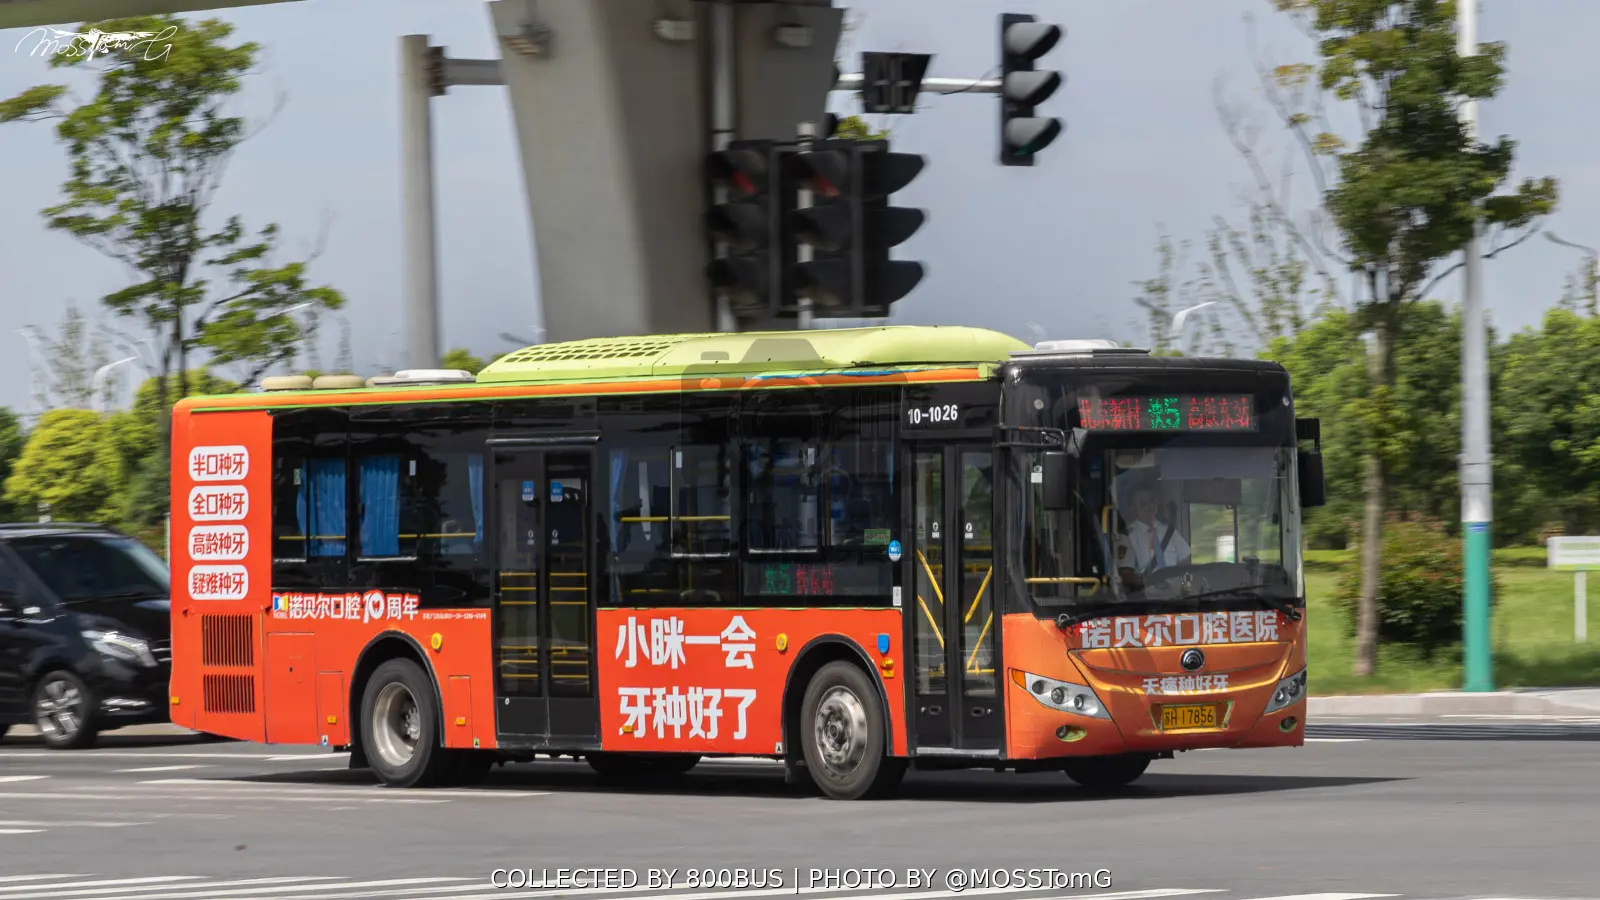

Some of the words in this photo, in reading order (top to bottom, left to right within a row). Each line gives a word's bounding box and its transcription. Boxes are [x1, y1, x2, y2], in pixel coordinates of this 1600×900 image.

[907, 404, 959, 425] 10-1026
[192, 452, 246, 476] 半口种牙
[192, 492, 246, 516] 全口种牙
[192, 532, 246, 556] 高龄种牙
[192, 572, 246, 596] 疑难种牙
[1079, 611, 1280, 649] 诺贝尔口腔医院
[615, 615, 757, 670] 小眯一会
[617, 686, 757, 740] 牙种好了
